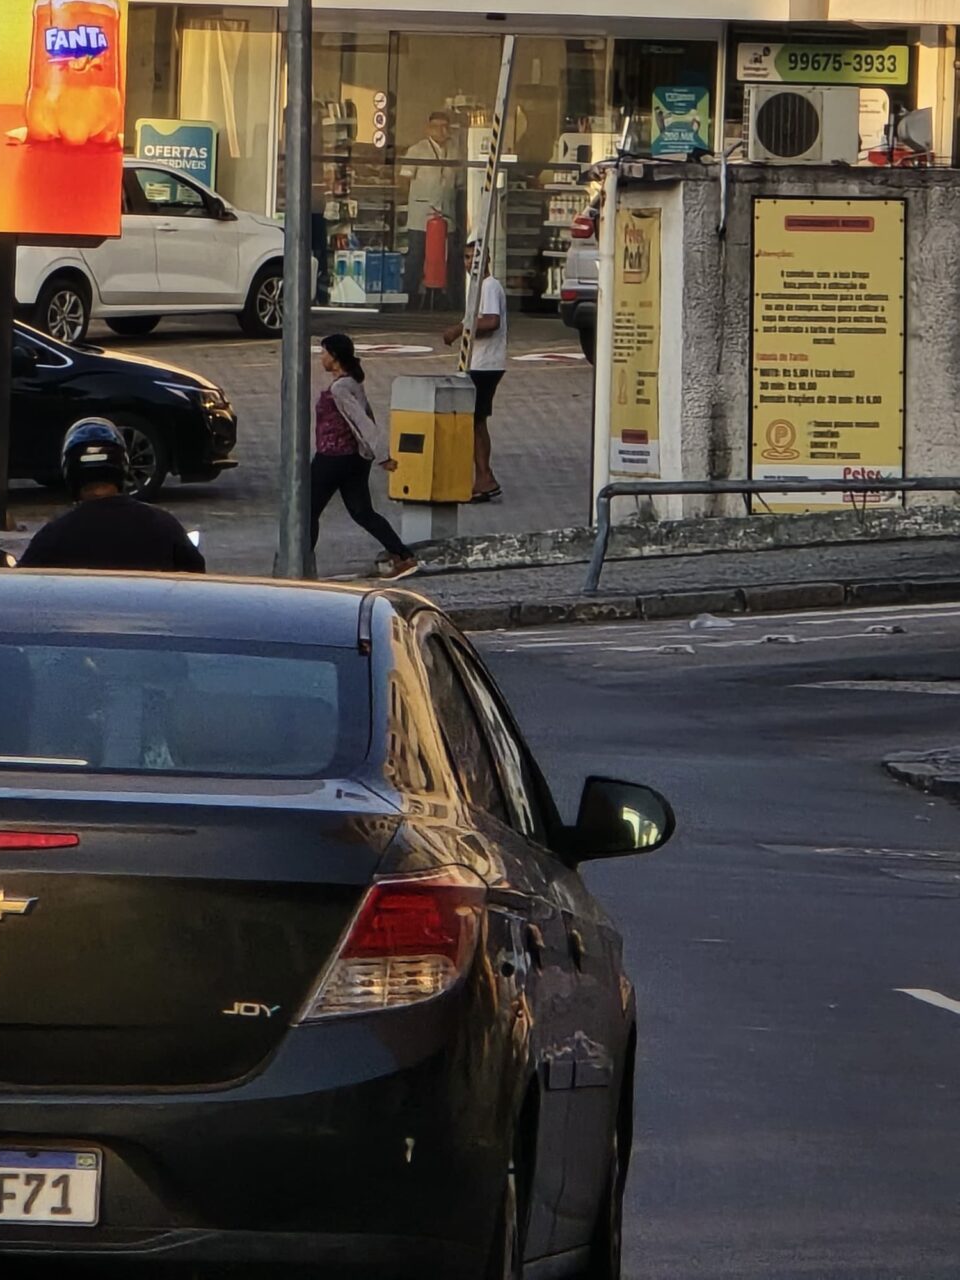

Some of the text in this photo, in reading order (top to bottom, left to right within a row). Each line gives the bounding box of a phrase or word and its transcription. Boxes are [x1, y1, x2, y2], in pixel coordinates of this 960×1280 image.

[45, 26, 109, 51] FANTA
[788, 53, 897, 73] 99675-3933
[144, 145, 208, 159] OFERTAS
[222, 1001, 280, 1018] JOY
